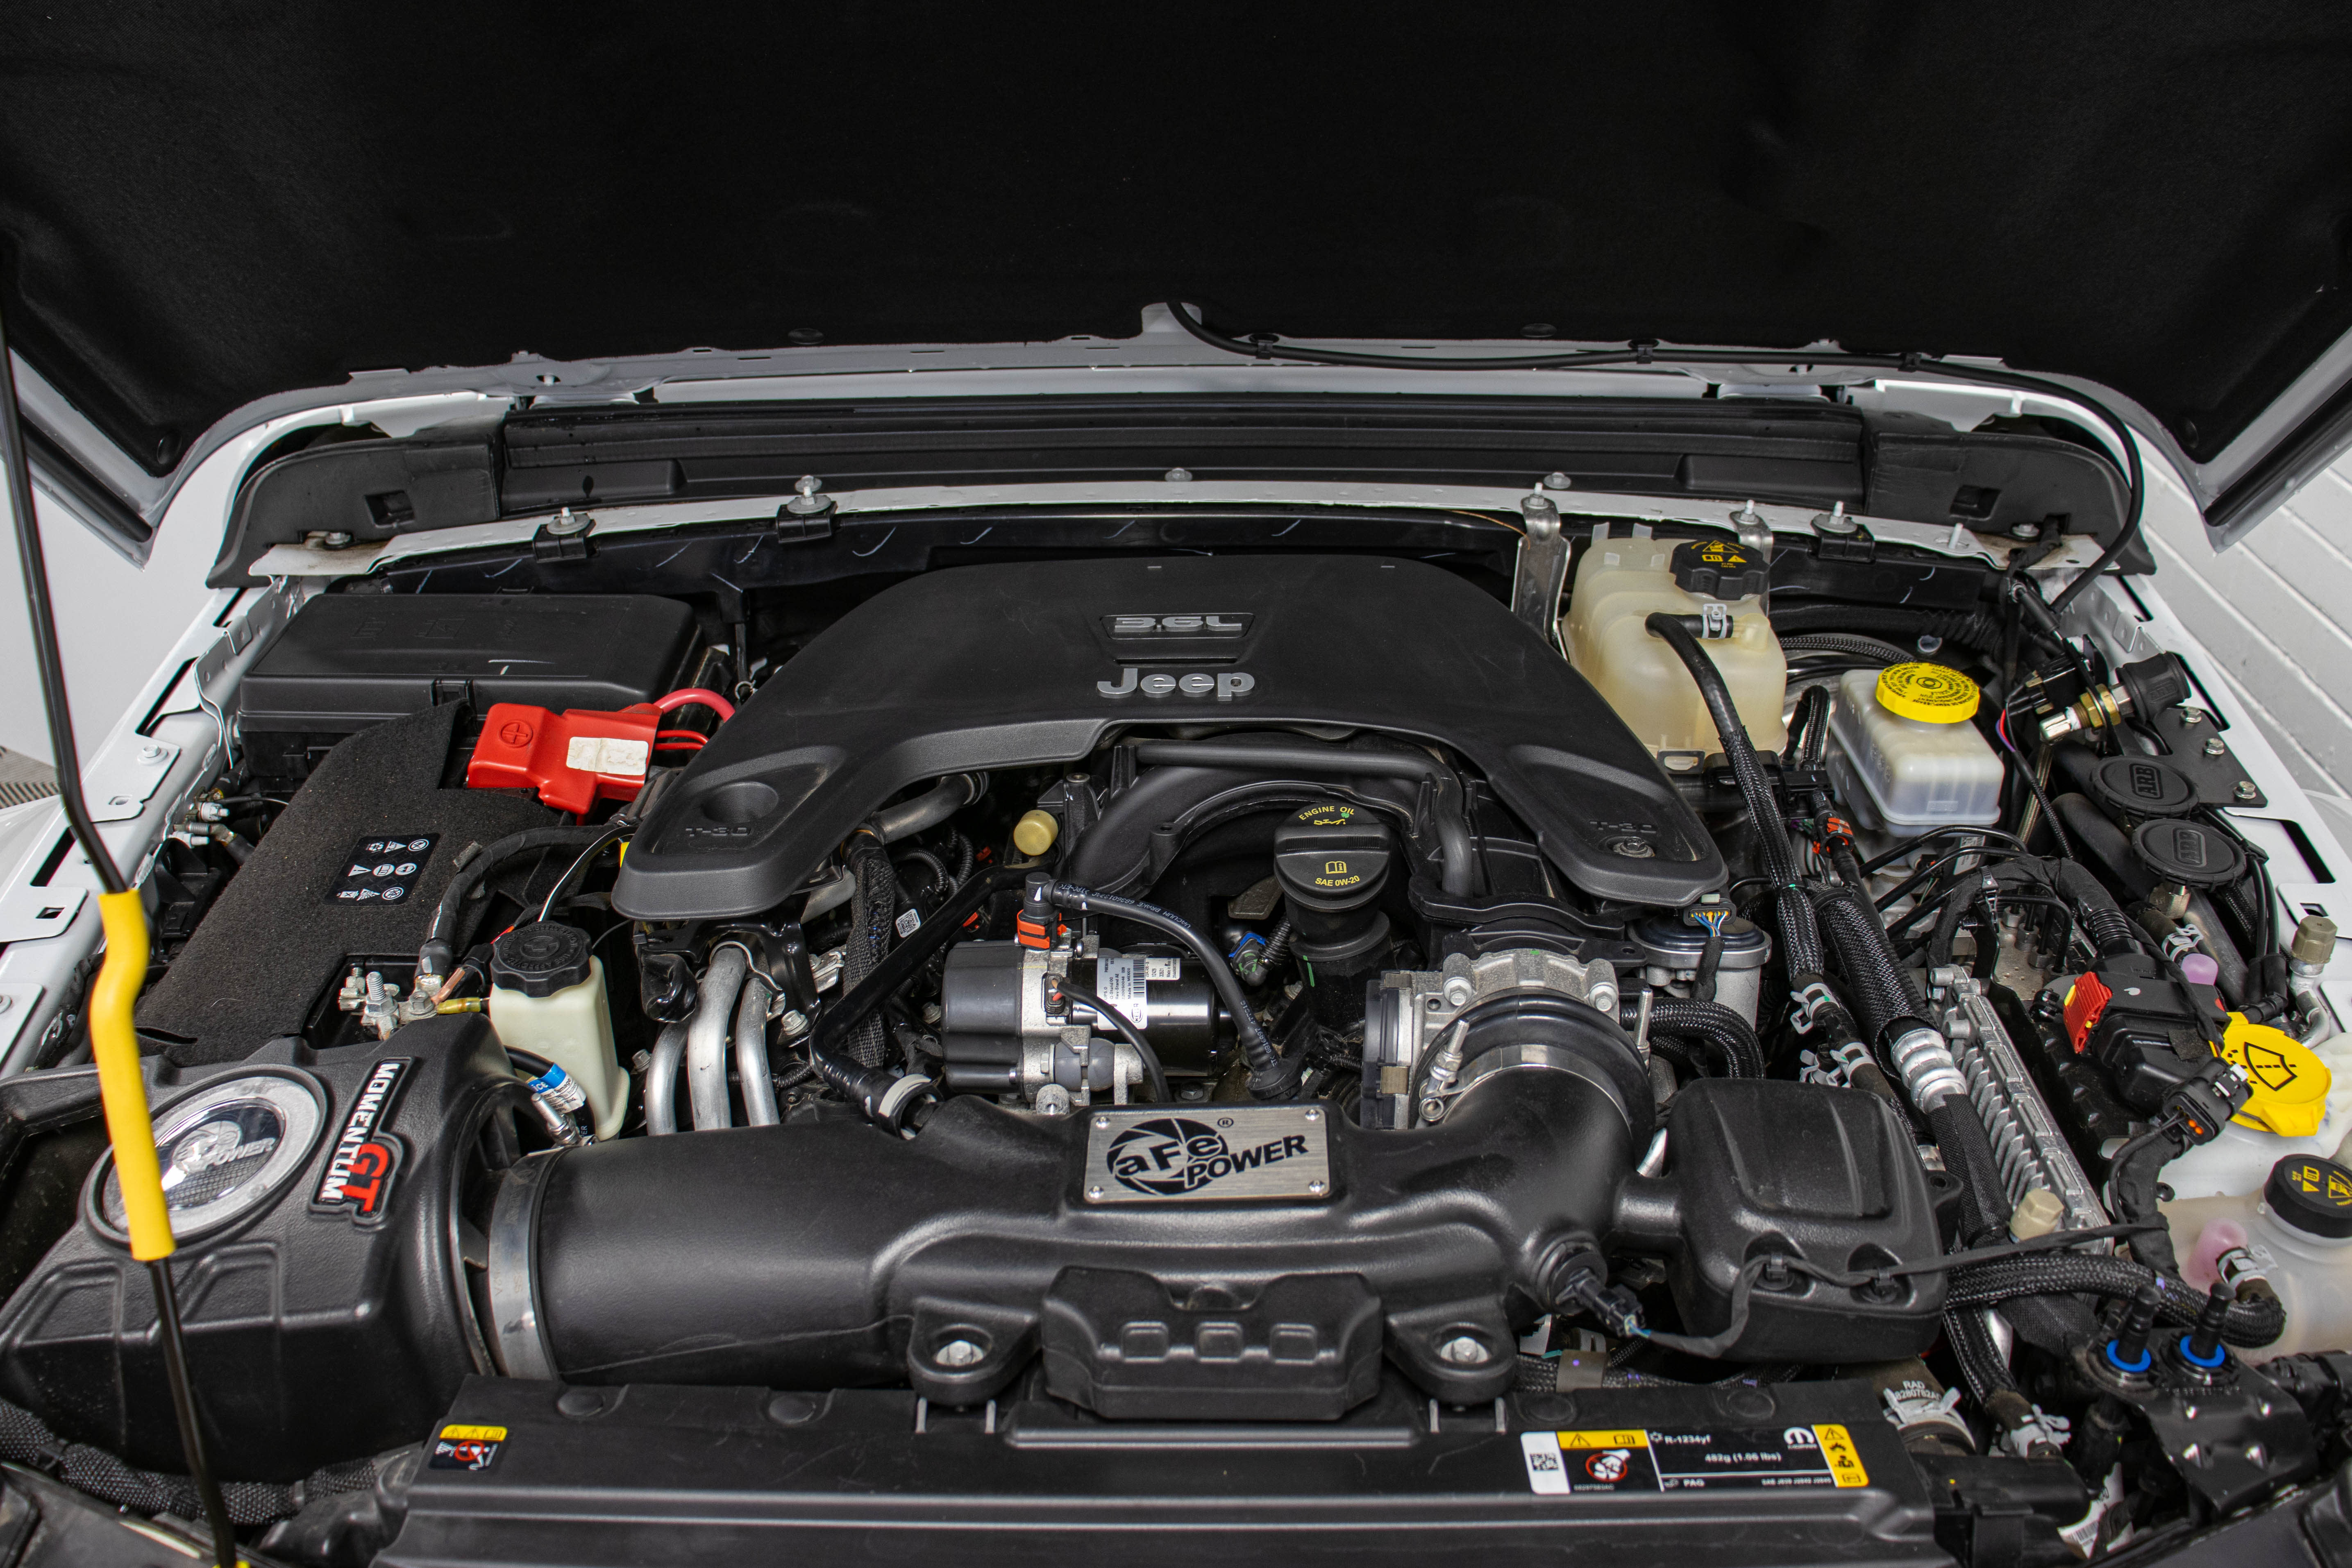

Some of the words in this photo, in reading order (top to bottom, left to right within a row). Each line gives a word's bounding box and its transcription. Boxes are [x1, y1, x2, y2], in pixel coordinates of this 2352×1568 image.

[1114, 616, 1242, 632] 3.6L
[1097, 668, 1255, 701] Jeep
[2136, 767, 2157, 796] ARB
[1299, 806, 1335, 820] ENGINE
[1340, 806, 1354, 815] OIL
[2179, 832, 2200, 863] ARB
[1315, 878, 1333, 886] SAE
[1335, 875, 1360, 886] 0W-20
[1137, 901, 1161, 912] BRAKE
[1163, 910, 1191, 928] VACUUM
[321, 1063, 401, 1200] MOMENTUM
[1115, 1135, 1224, 1177] aFe
[1185, 1134, 1309, 1189] POWER
[343, 1143, 390, 1212] GT
[1903, 1380, 1925, 1390] RAD
[1664, 1434, 1712, 1445] R-1234yf
[1760, 1452, 1782, 1463] lbs)
[1683, 1479, 1705, 1487] PAG
